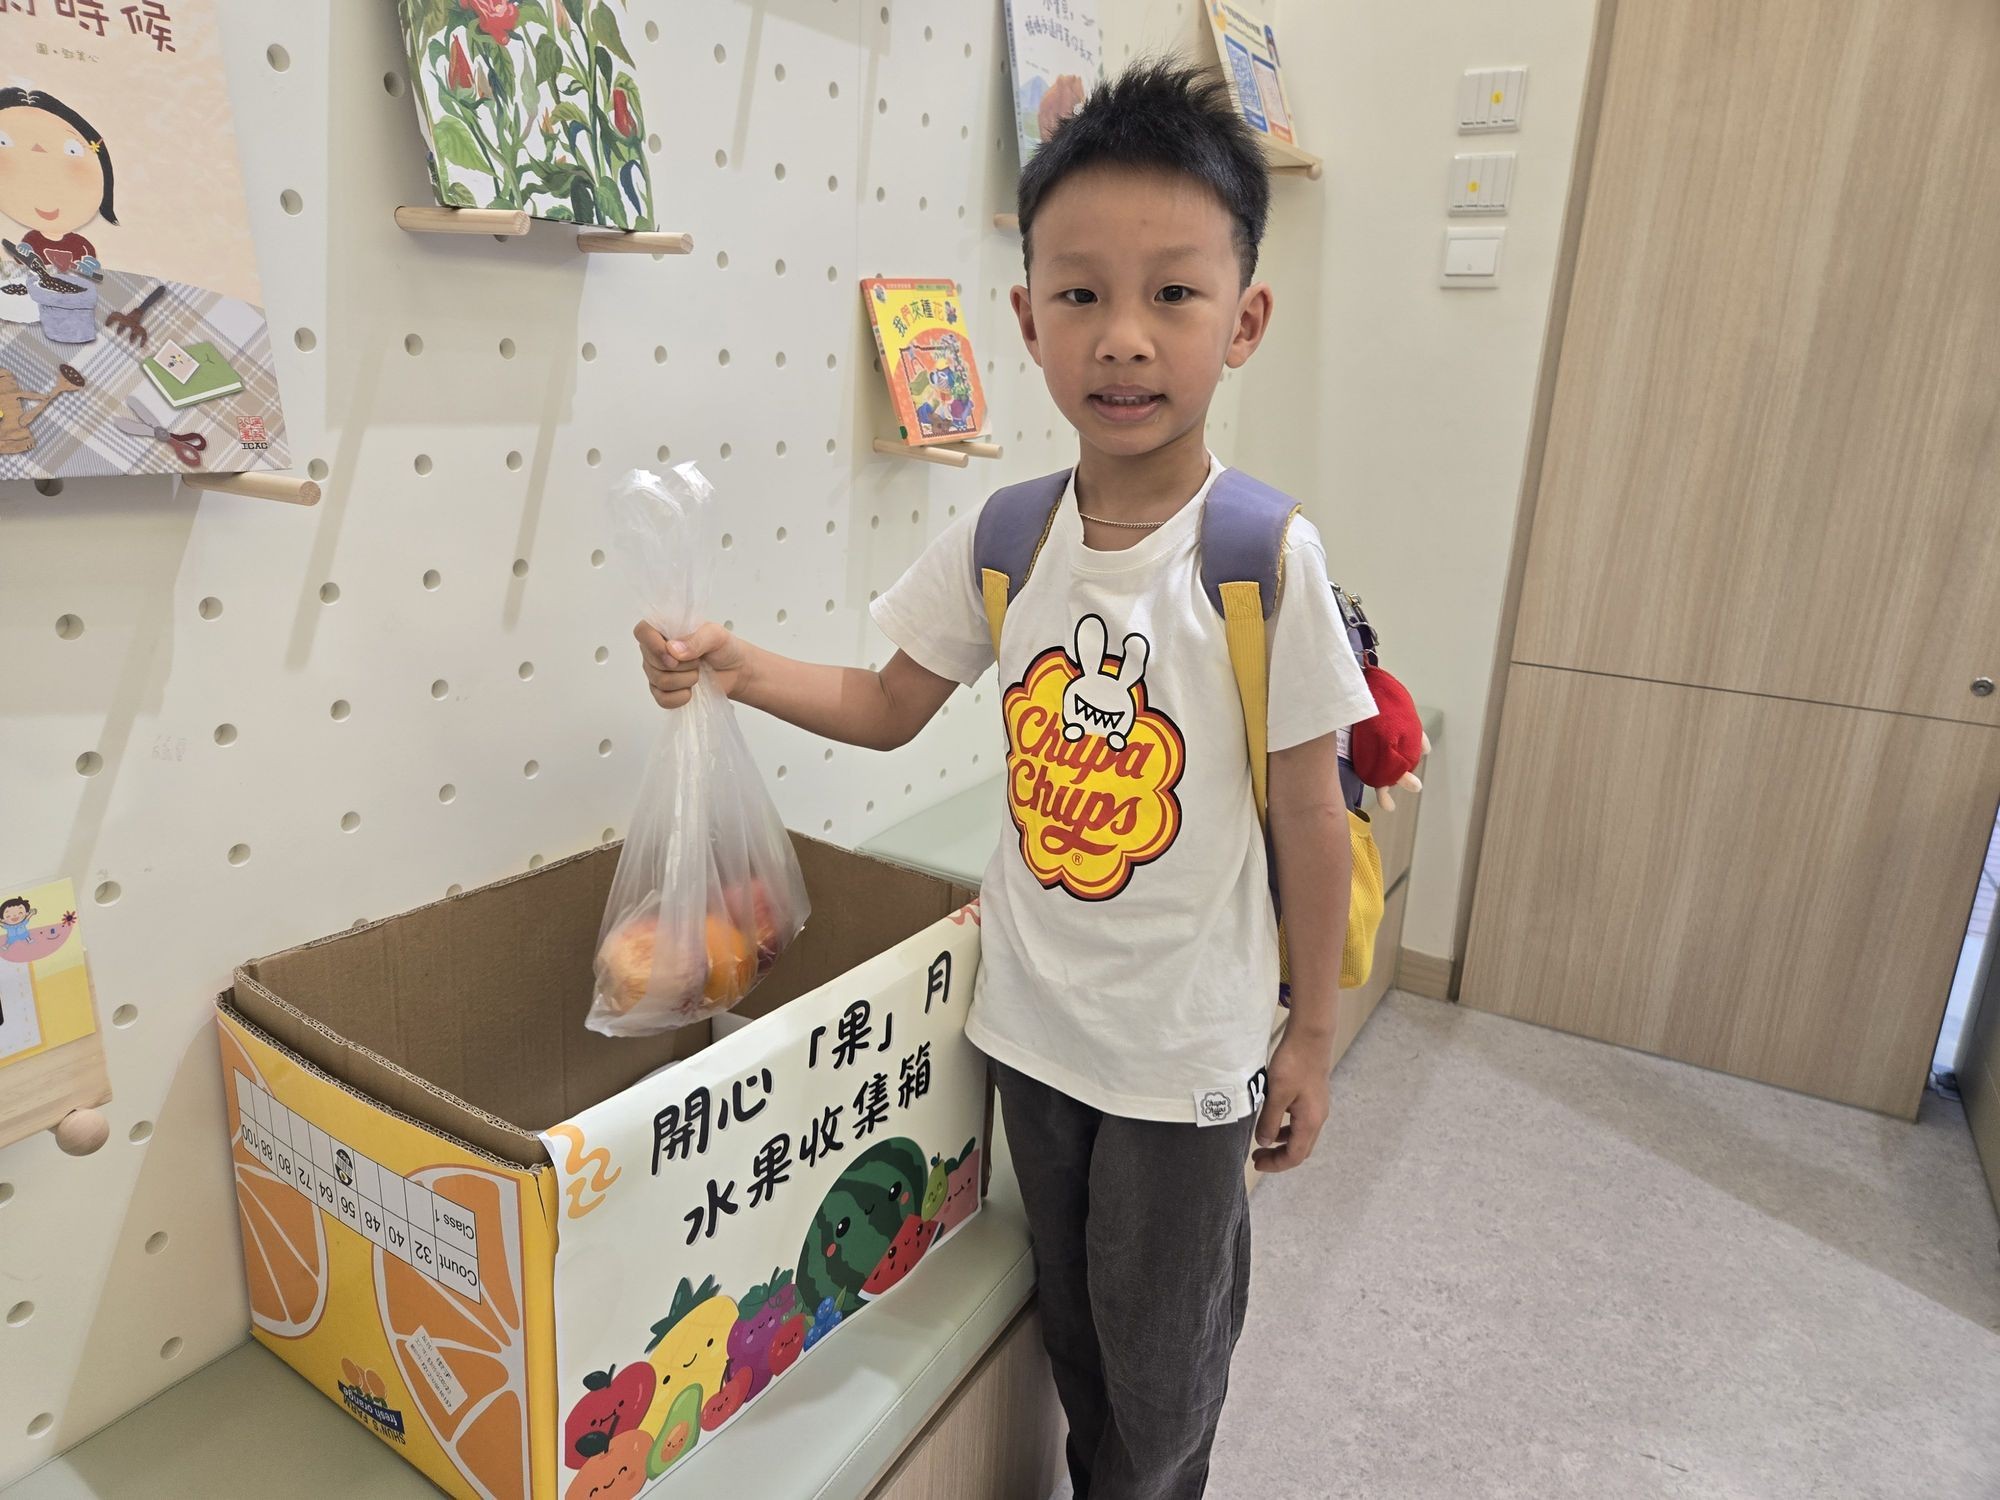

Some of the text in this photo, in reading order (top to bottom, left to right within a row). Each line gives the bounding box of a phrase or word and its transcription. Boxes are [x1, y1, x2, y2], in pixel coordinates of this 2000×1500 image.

[0, 0, 178, 53] 時候
[892, 299, 945, 338] 我們來種花
[1016, 705, 1155, 785] Chupa
[1011, 758, 1143, 856] Chups
[683, 1041, 932, 1246] 水果收集箱
[242, 1124, 478, 1287] Count 32 40 48 56 64 72 80 88 100
[434, 1208, 475, 1240] Class 1
[343, 1386, 398, 1427] fresh orange
[372, 1419, 406, 1446] SHUN'S
